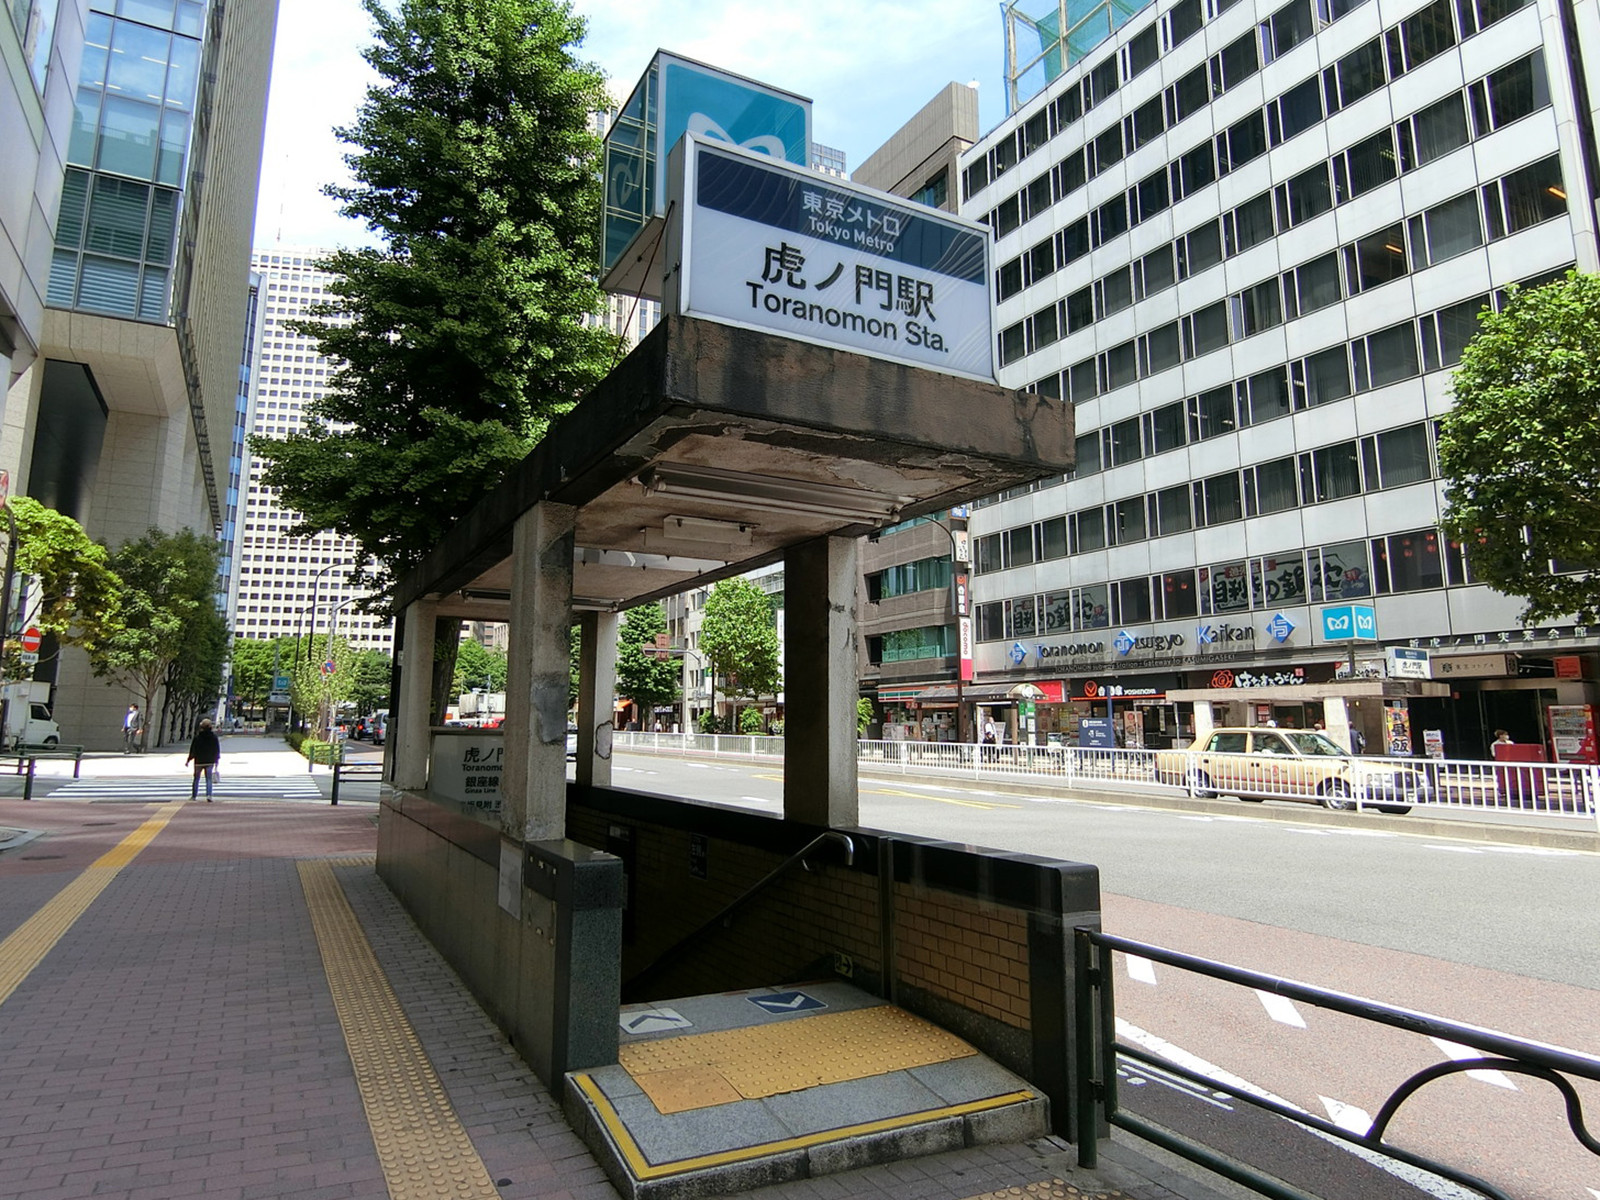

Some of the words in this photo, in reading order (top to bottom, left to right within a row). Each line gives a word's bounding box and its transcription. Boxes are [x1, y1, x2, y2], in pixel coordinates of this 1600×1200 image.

[802, 190, 900, 237] 東京メトロ
[808, 215, 851, 240] Tokyo
[853, 228, 895, 253] Metro
[761, 241, 937, 323] 虎ノ門駅
[746, 281, 898, 341] Toranomon
[904, 320, 949, 353] Sta.
[1035, 641, 1104, 659] Toranomon
[1196, 623, 1255, 645] Kaikan
[465, 776, 499, 788] 銀座線
